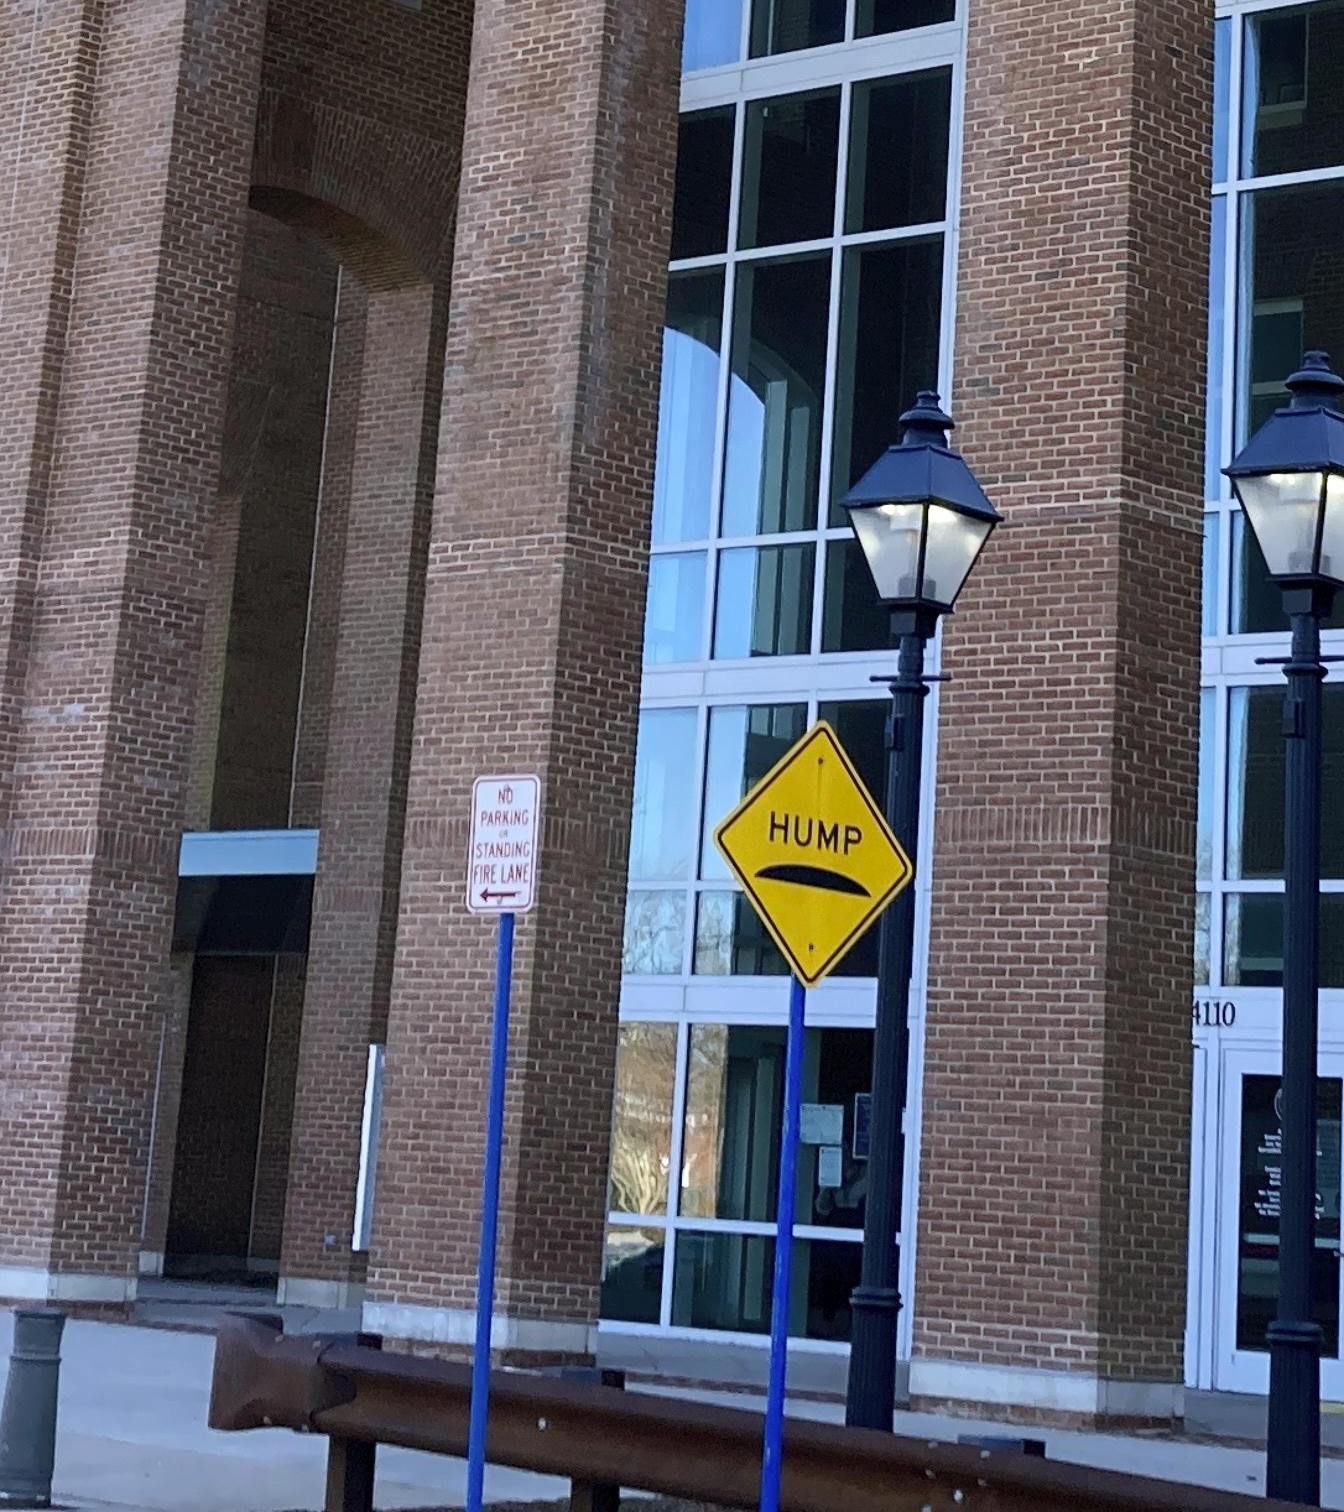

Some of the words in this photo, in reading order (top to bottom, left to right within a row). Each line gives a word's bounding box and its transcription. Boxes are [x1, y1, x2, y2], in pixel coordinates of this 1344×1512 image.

[498, 787, 513, 804] NO
[481, 810, 529, 826] PARKING
[499, 829, 509, 839] OR
[769, 811, 863, 855] HUMP
[476, 841, 530, 859] STANDING
[474, 864, 496, 884] FIRE
[501, 864, 529, 884] LANE
